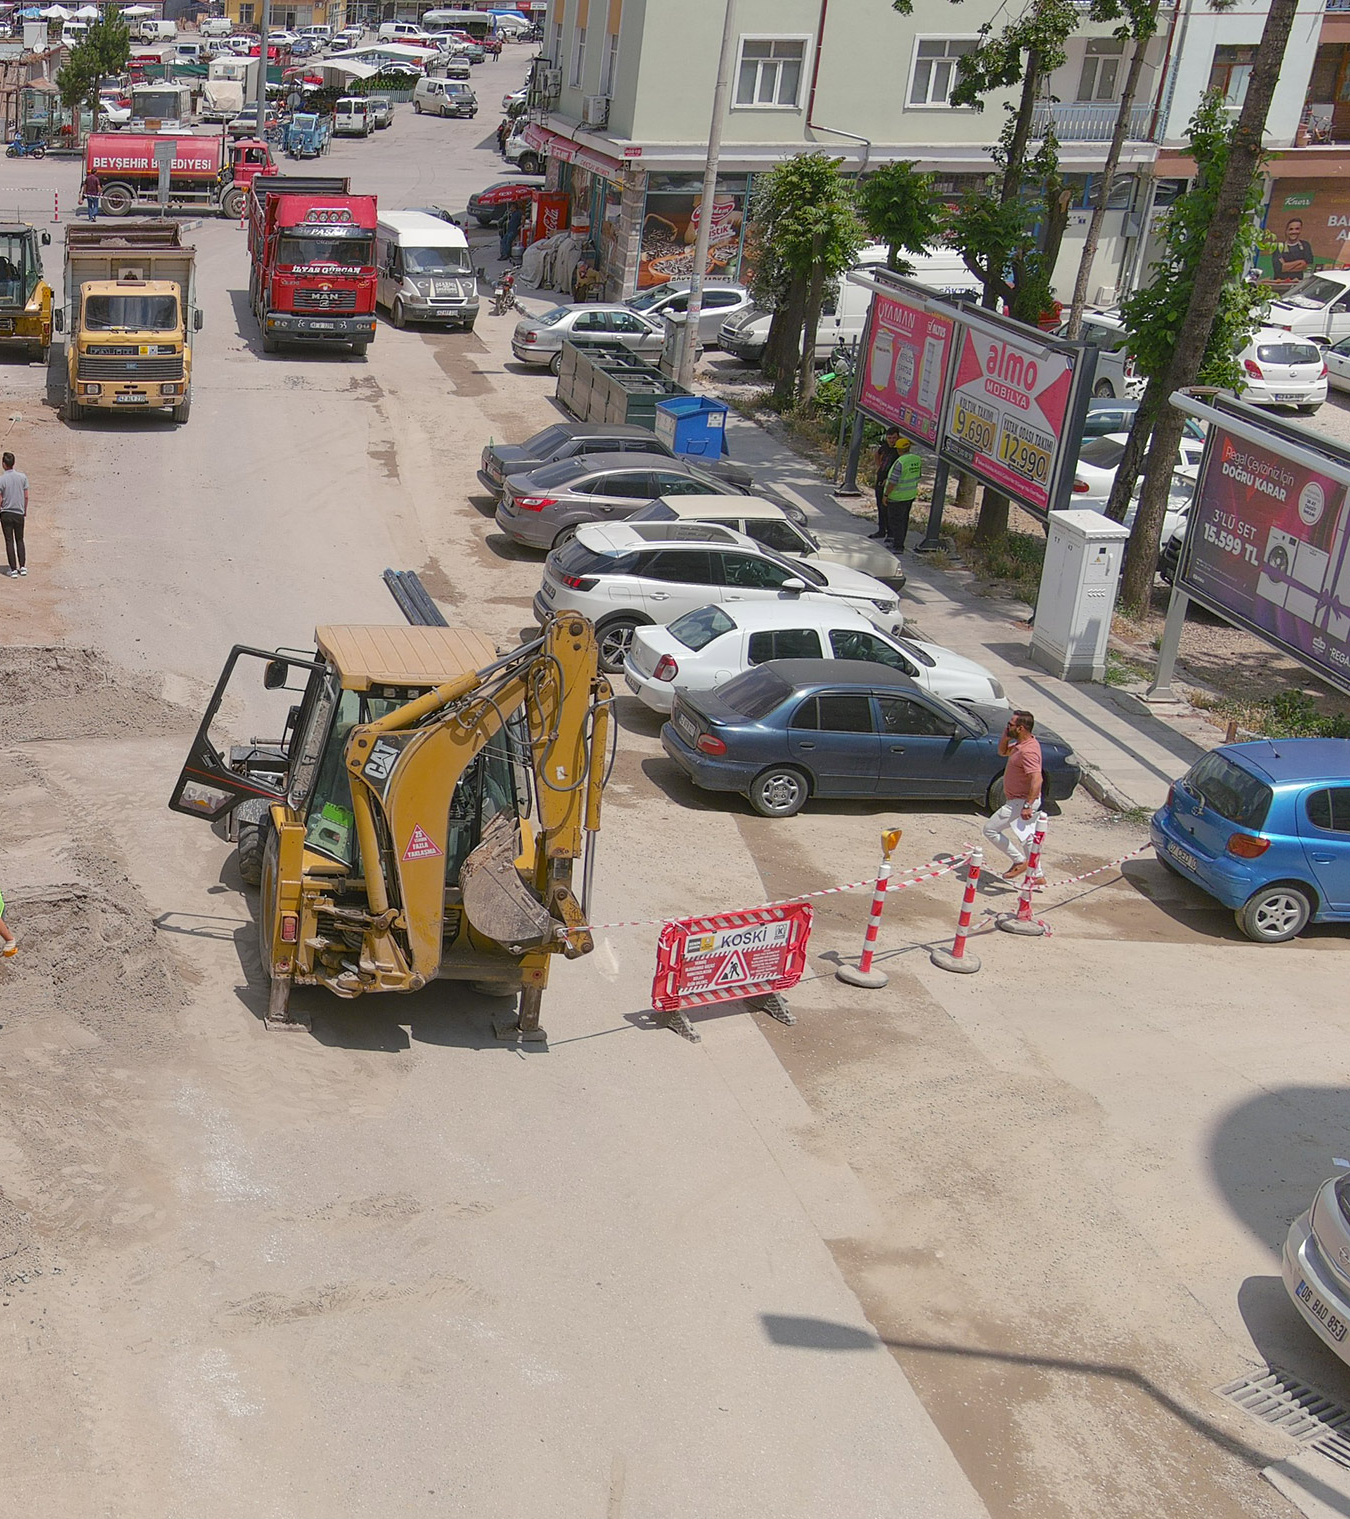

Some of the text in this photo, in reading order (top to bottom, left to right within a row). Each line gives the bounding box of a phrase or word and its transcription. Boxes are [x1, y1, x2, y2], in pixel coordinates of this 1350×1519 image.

[93, 157, 212, 170] BEYŞEHİR BEDİYESİ
[1284, 196, 1311, 205] Knorr
[986, 341, 1038, 392] almo
[985, 380, 1028, 408] MOBİLYA
[956, 411, 991, 448] 9.690
[1020, 424, 1035, 442] ODASI
[1004, 433, 1046, 478] 12.990
[1225, 446, 1295, 487] Regal Çeyiziniz İçin
[1222, 462, 1254, 486] DOĞRU
[1254, 478, 1287, 502] KARAR
[1203, 522, 1259, 567] 15.599 TL
[1237, 522, 1257, 540] SET
[364, 739, 401, 780] CAT
[720, 926, 768, 949] KOSKİ
[1301, 1286, 1345, 1337] 06 BAD 853
